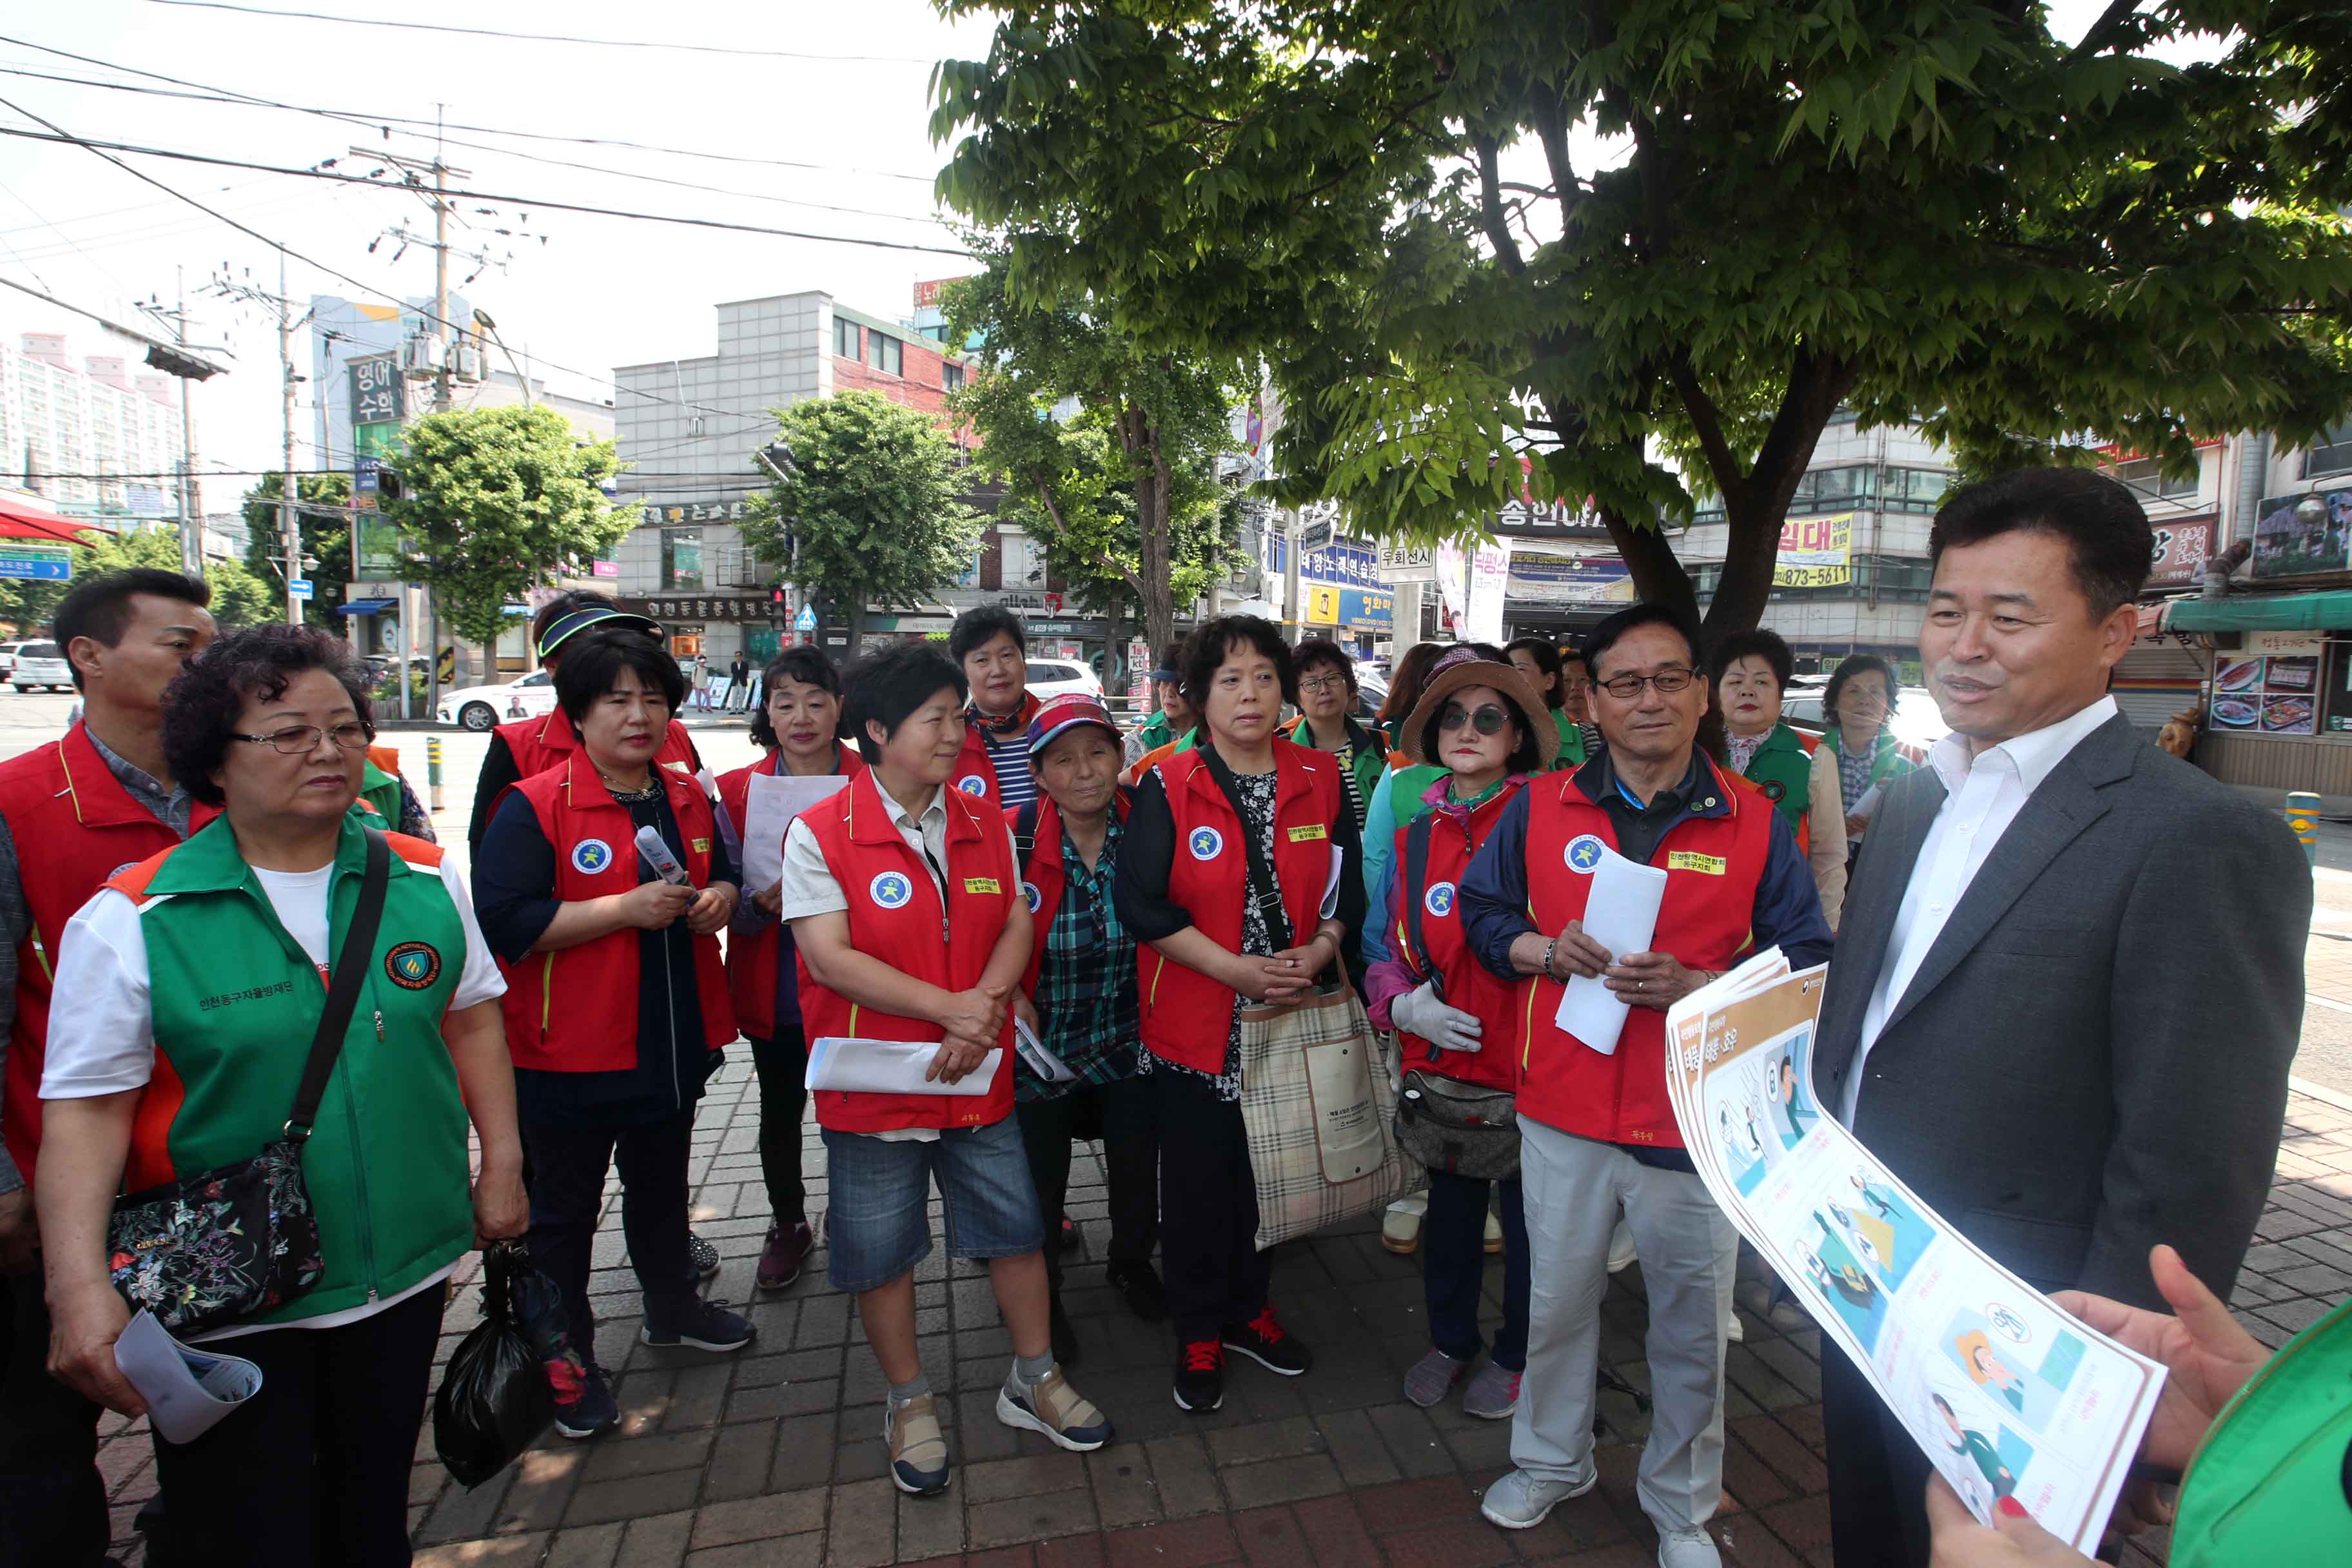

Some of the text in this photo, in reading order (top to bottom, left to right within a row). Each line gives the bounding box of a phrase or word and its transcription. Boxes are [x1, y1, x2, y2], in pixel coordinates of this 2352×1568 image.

[358, 361, 391, 391] 영어
[360, 390, 395, 420] 수학
[1502, 500, 1604, 527] 송현야
[1778, 520, 1832, 552] 임대
[1382, 549, 1431, 565] 우회전시
[1362, 596, 1393, 615] 영화마
[199, 981, 294, 1011] 인천동구자율방재단
